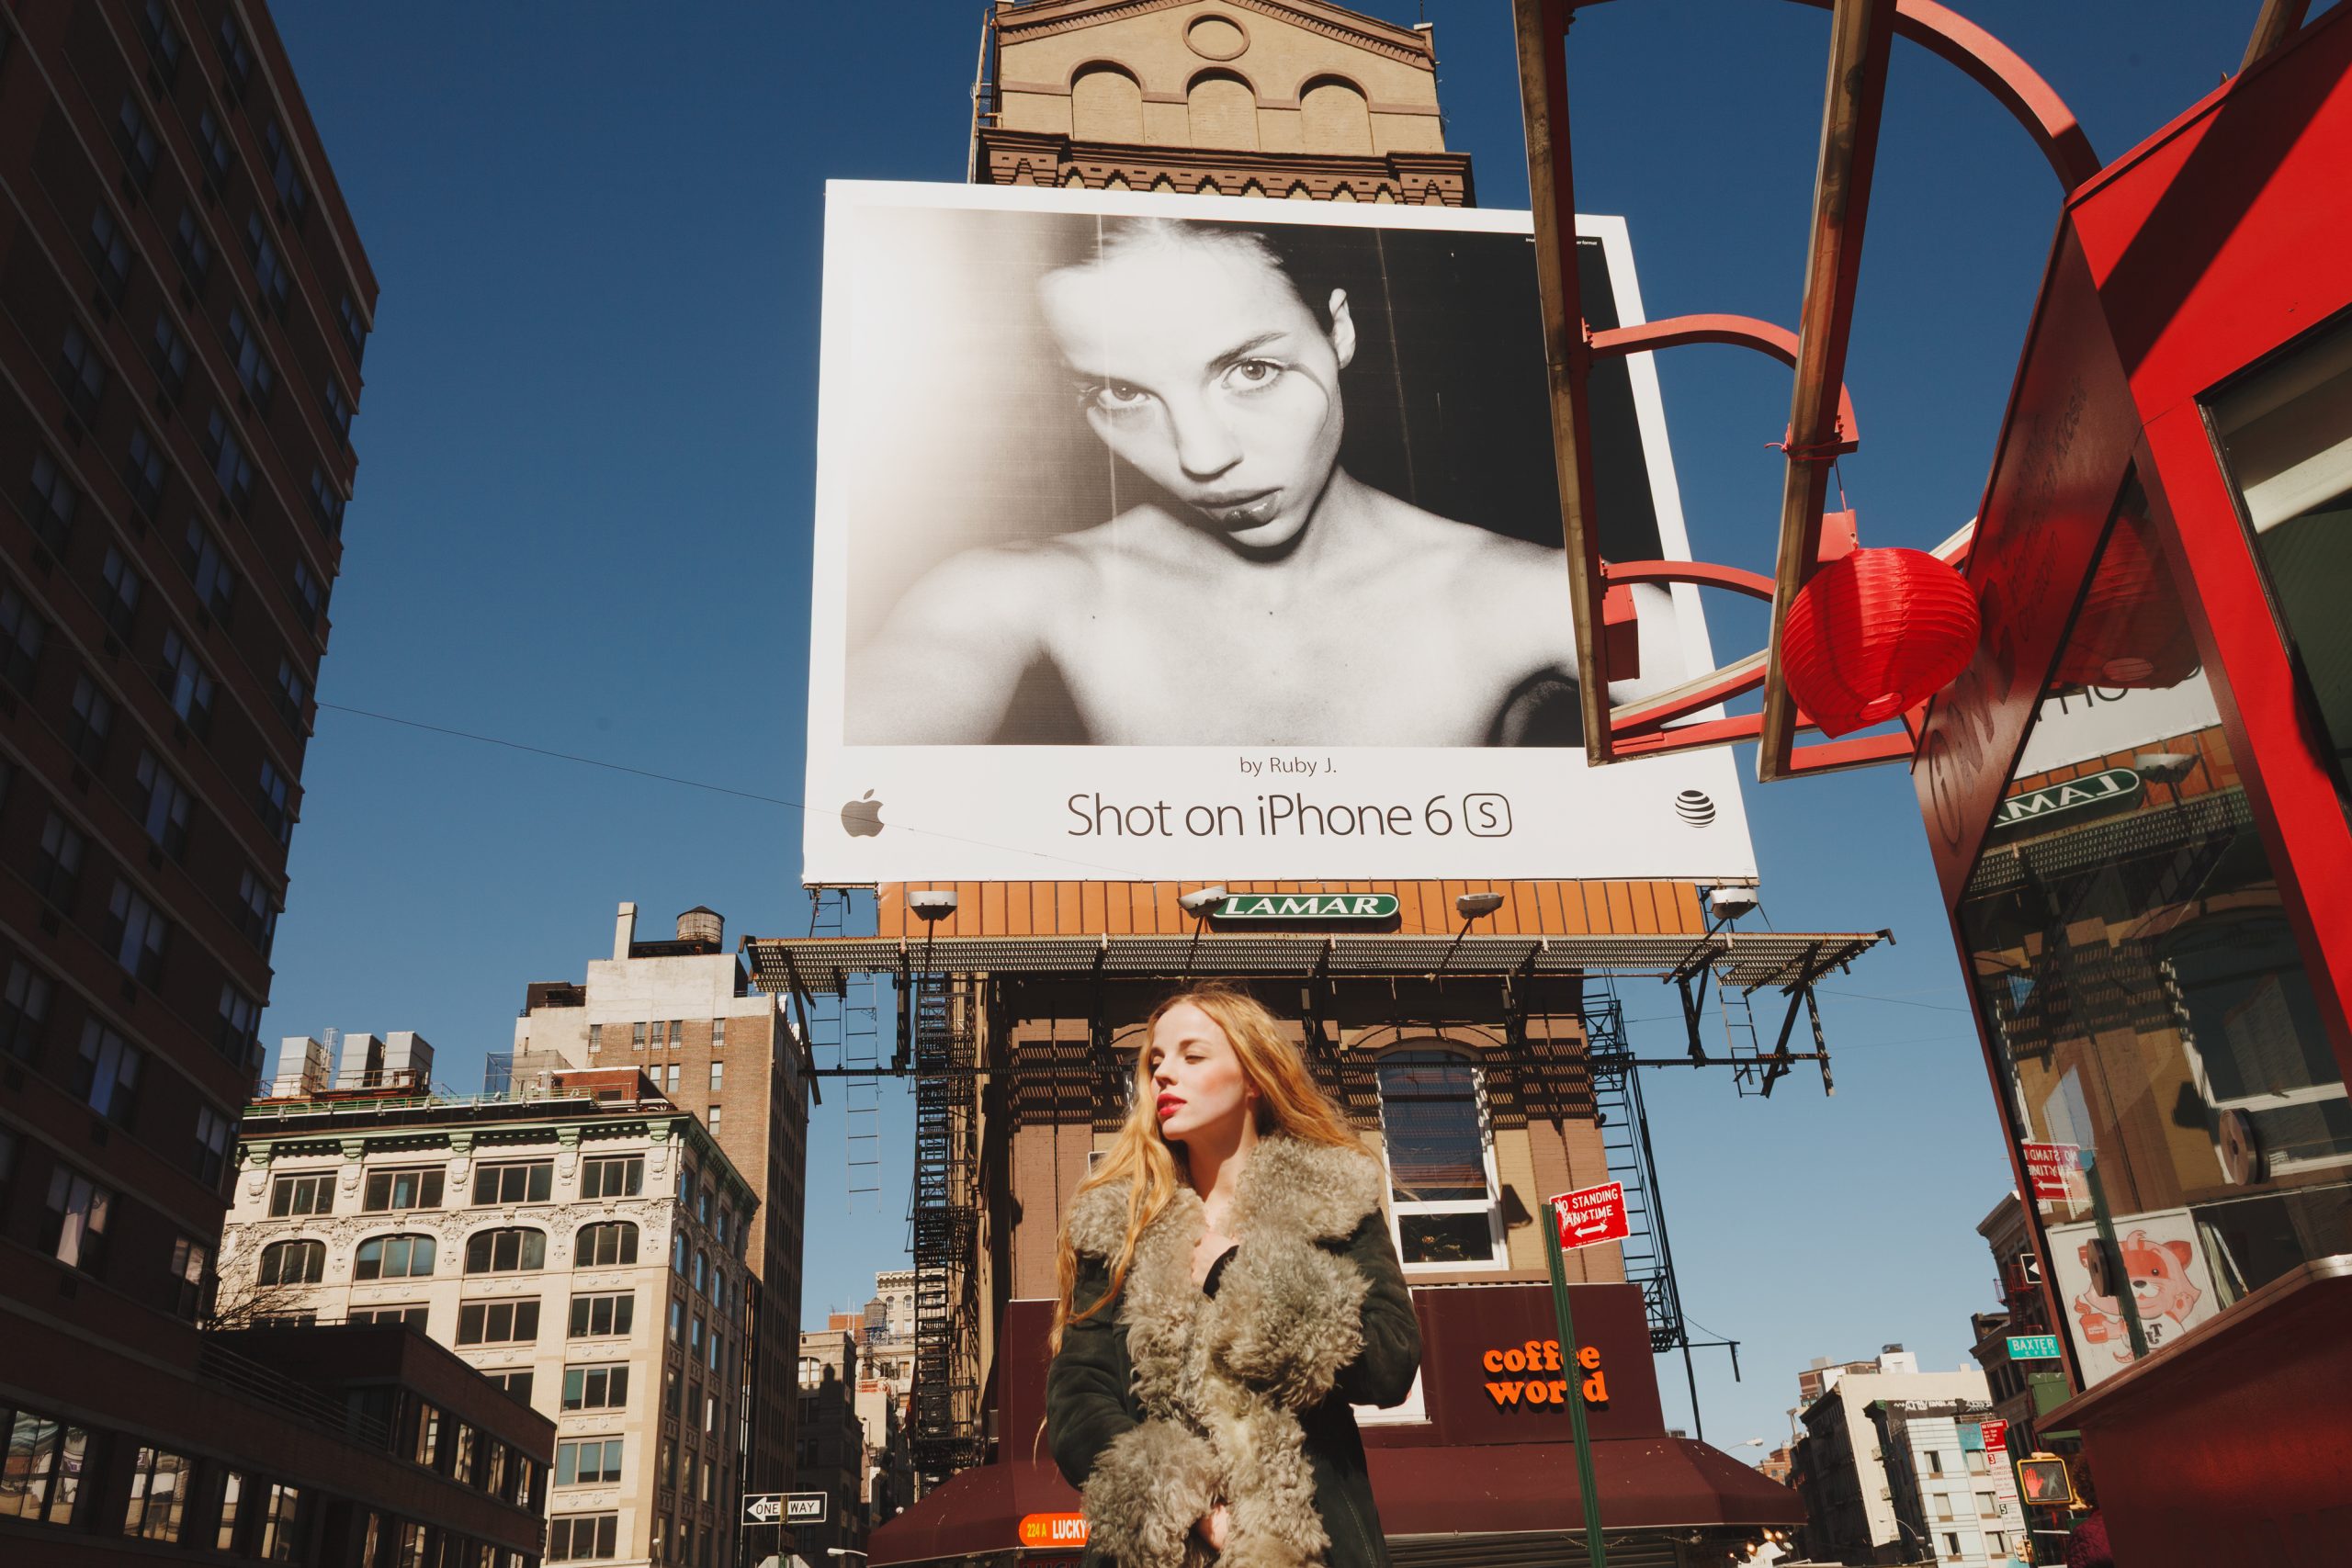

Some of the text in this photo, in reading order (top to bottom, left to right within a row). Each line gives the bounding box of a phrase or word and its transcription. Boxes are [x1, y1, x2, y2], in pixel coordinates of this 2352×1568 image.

[1239, 757, 1338, 777] by Ruby J.
[1067, 792, 1173, 836] Shot
[1185, 805, 1244, 836] on
[1257, 792, 1413, 836] iPhone
[1424, 795, 1453, 836] 6
[1224, 897, 1380, 915] LAMAR
[1555, 1188, 1618, 1213] NO STANDING
[1565, 1204, 1614, 1227] ANYTIME
[2012, 1338, 2055, 1351] BAXTER
[1485, 1371, 1609, 1405] word
[756, 1502, 814, 1515] ONE WAY
[1027, 1519, 1087, 1540] 224 A LUCKY
